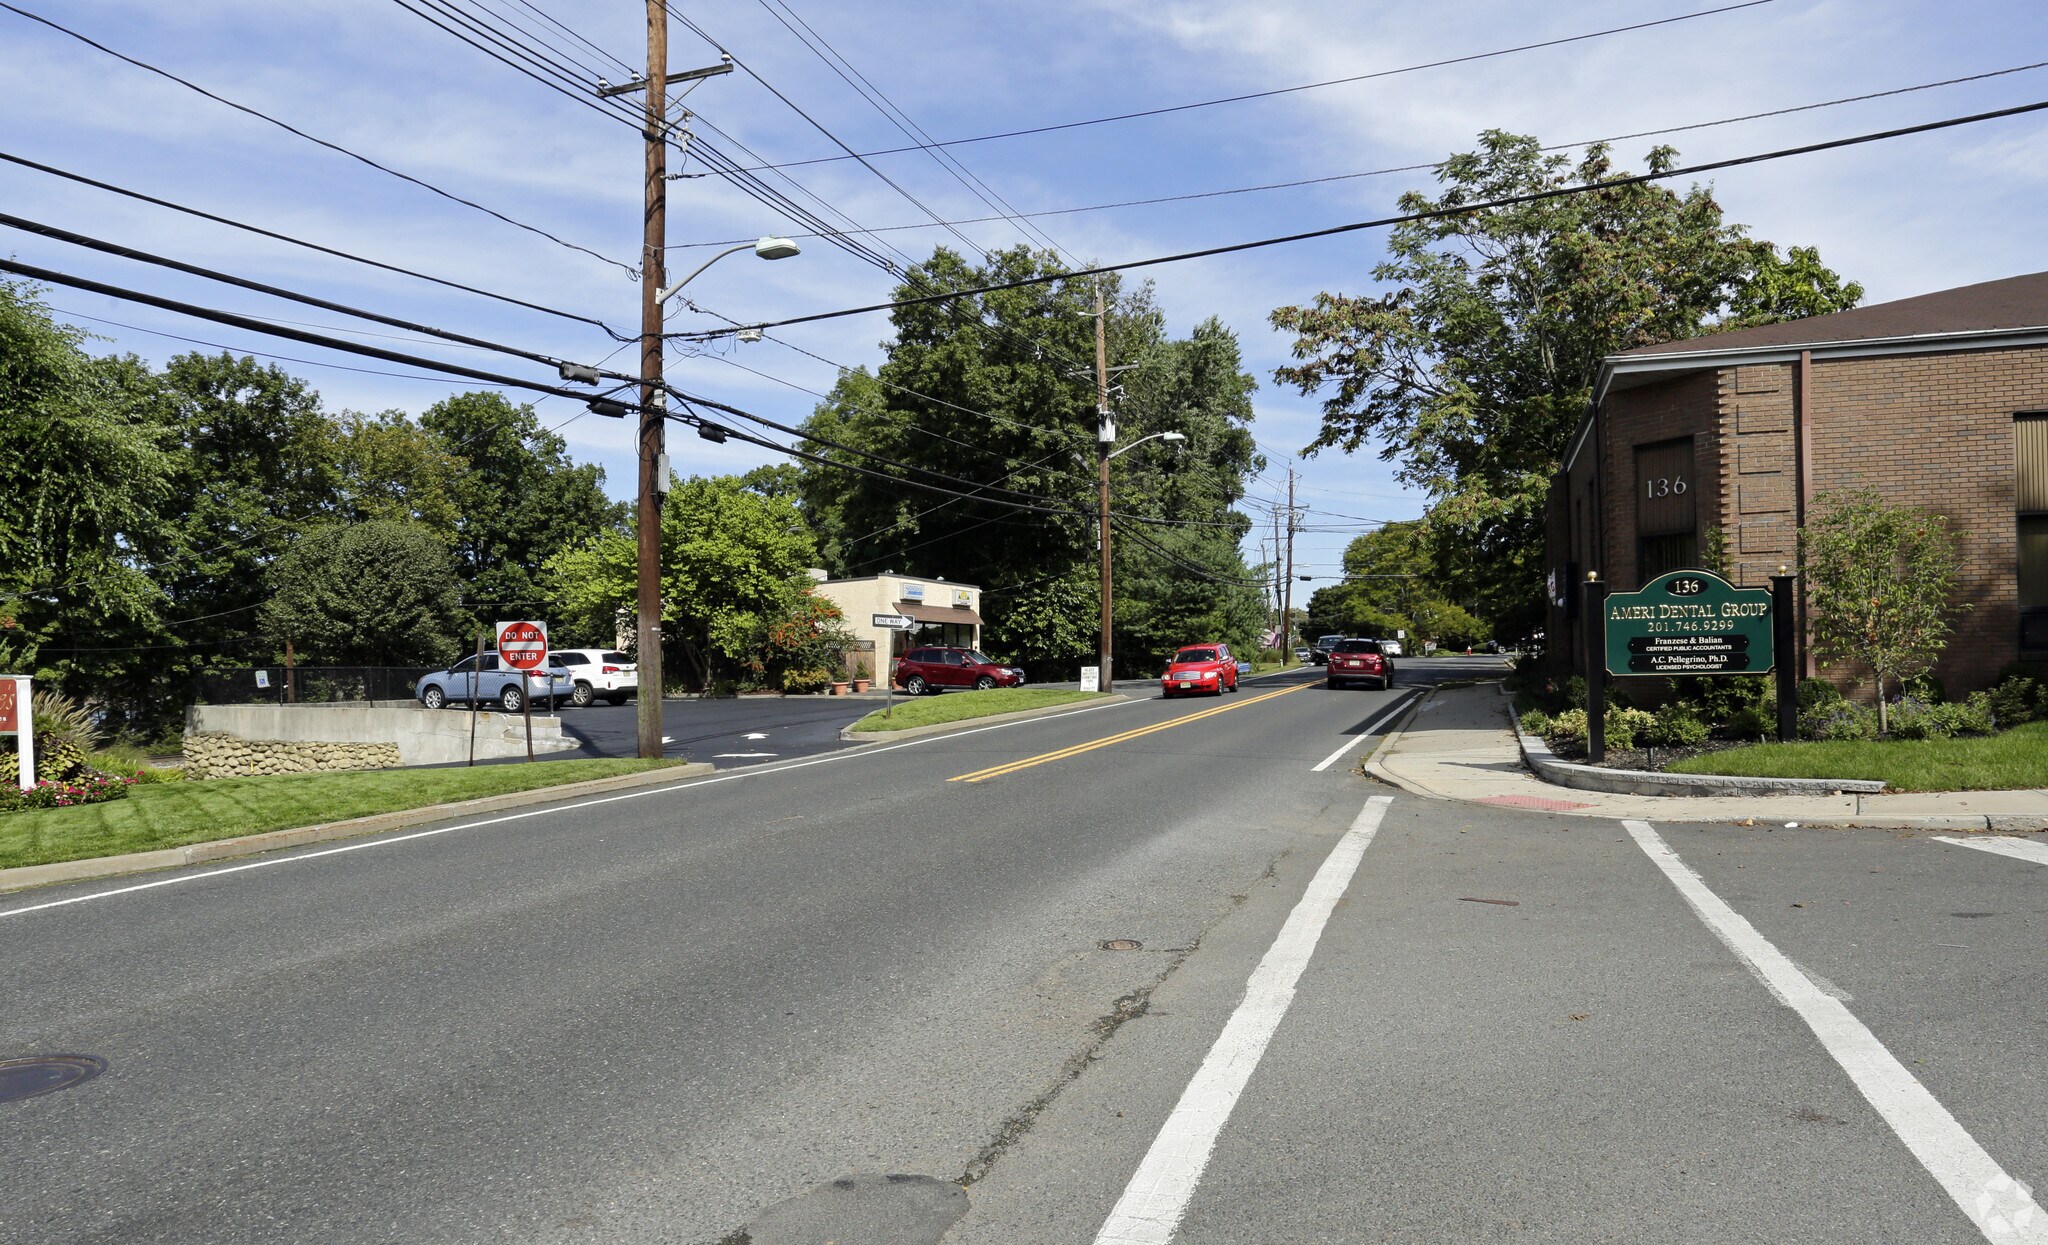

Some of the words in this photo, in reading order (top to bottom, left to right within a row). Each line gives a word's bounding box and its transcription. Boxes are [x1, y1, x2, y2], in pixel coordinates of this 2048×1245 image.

[1647, 475, 1687, 499] 136
[1675, 580, 1699, 594] 136
[1610, 606, 1655, 620] AMERI
[1659, 604, 1716, 618] DENTAL
[1721, 602, 1767, 617] GROUP
[876, 617, 888, 625] ONE
[1648, 620, 1734, 632] 201.746.9299
[505, 631, 517, 640] DO
[521, 631, 539, 640] NOT
[1655, 637, 1688, 645] Franzese
[1698, 636, 1723, 644] Balian
[509, 652, 538, 661] ENTER
[1668, 655, 1707, 665] Pellegrino,
